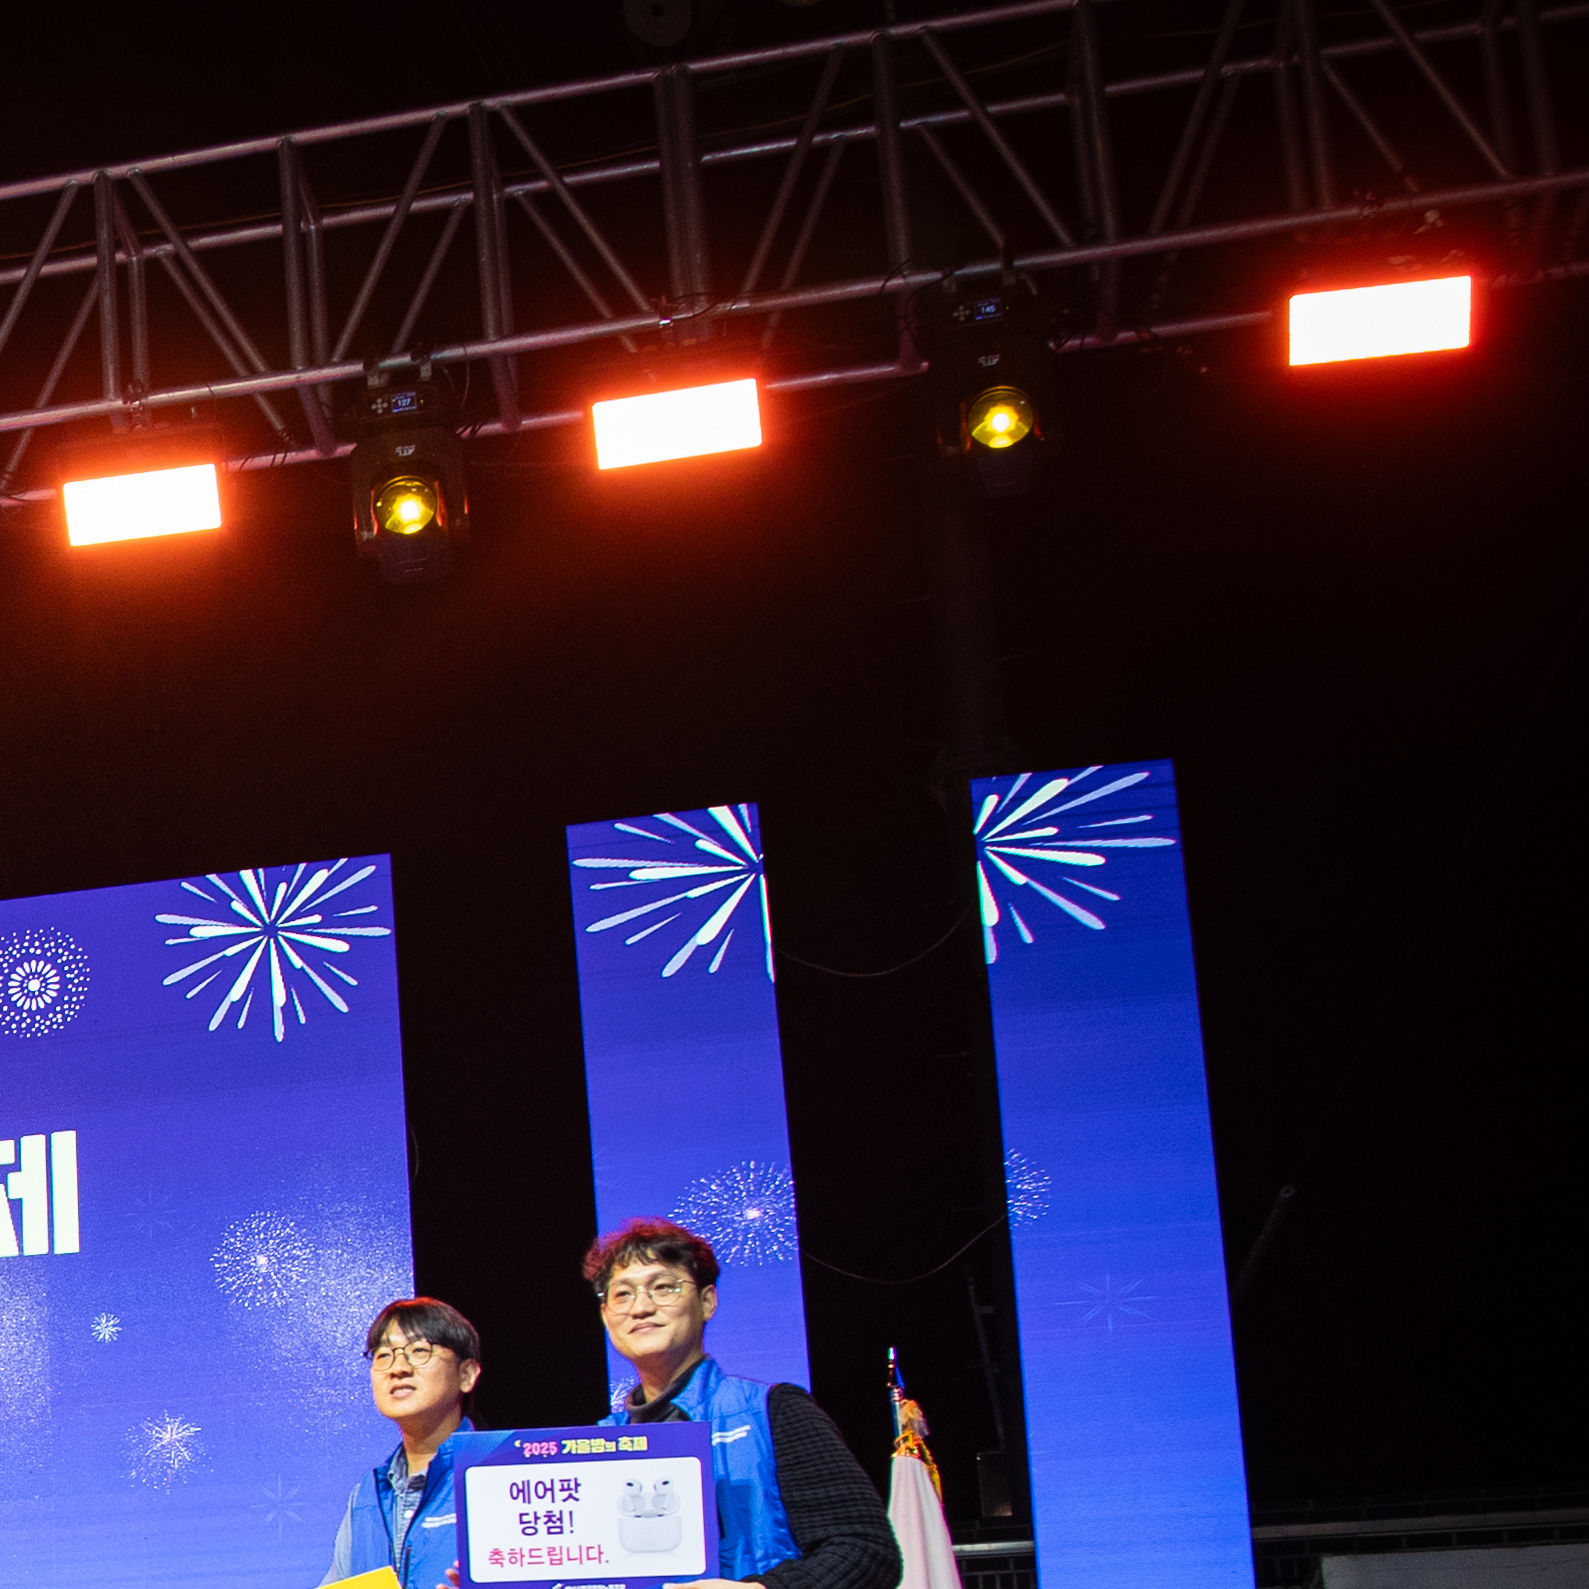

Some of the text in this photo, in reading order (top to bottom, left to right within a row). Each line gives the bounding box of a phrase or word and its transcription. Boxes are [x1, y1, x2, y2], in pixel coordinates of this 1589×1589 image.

[523, 1441, 558, 1458] 2025
[509, 1476, 582, 1505] 에어팟
[518, 1509, 575, 1537] 당첨!
[487, 1543, 610, 1569] 축하드립니다.
